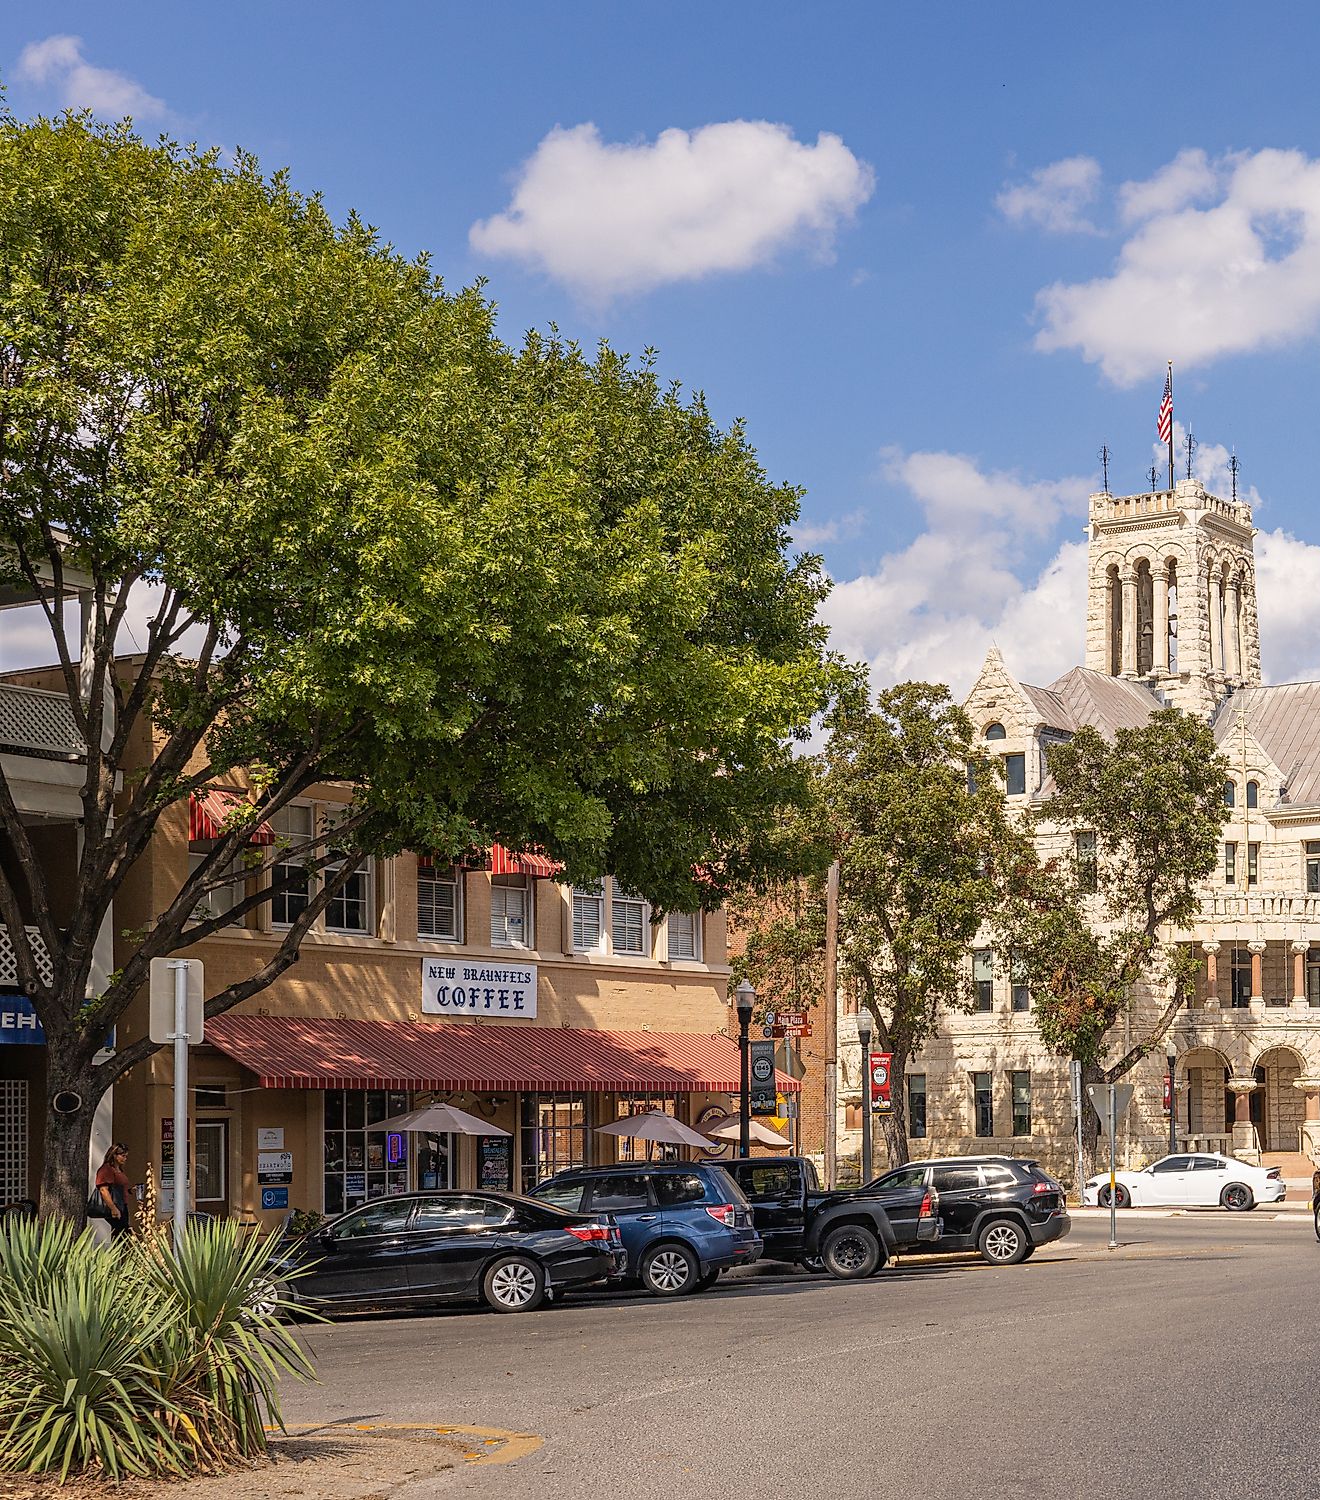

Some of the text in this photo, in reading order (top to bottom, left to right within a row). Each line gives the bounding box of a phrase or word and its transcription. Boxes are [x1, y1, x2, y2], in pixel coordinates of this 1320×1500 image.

[428, 965, 532, 984] NEW BRAUNFELS
[437, 985, 525, 1010] COFFEE
